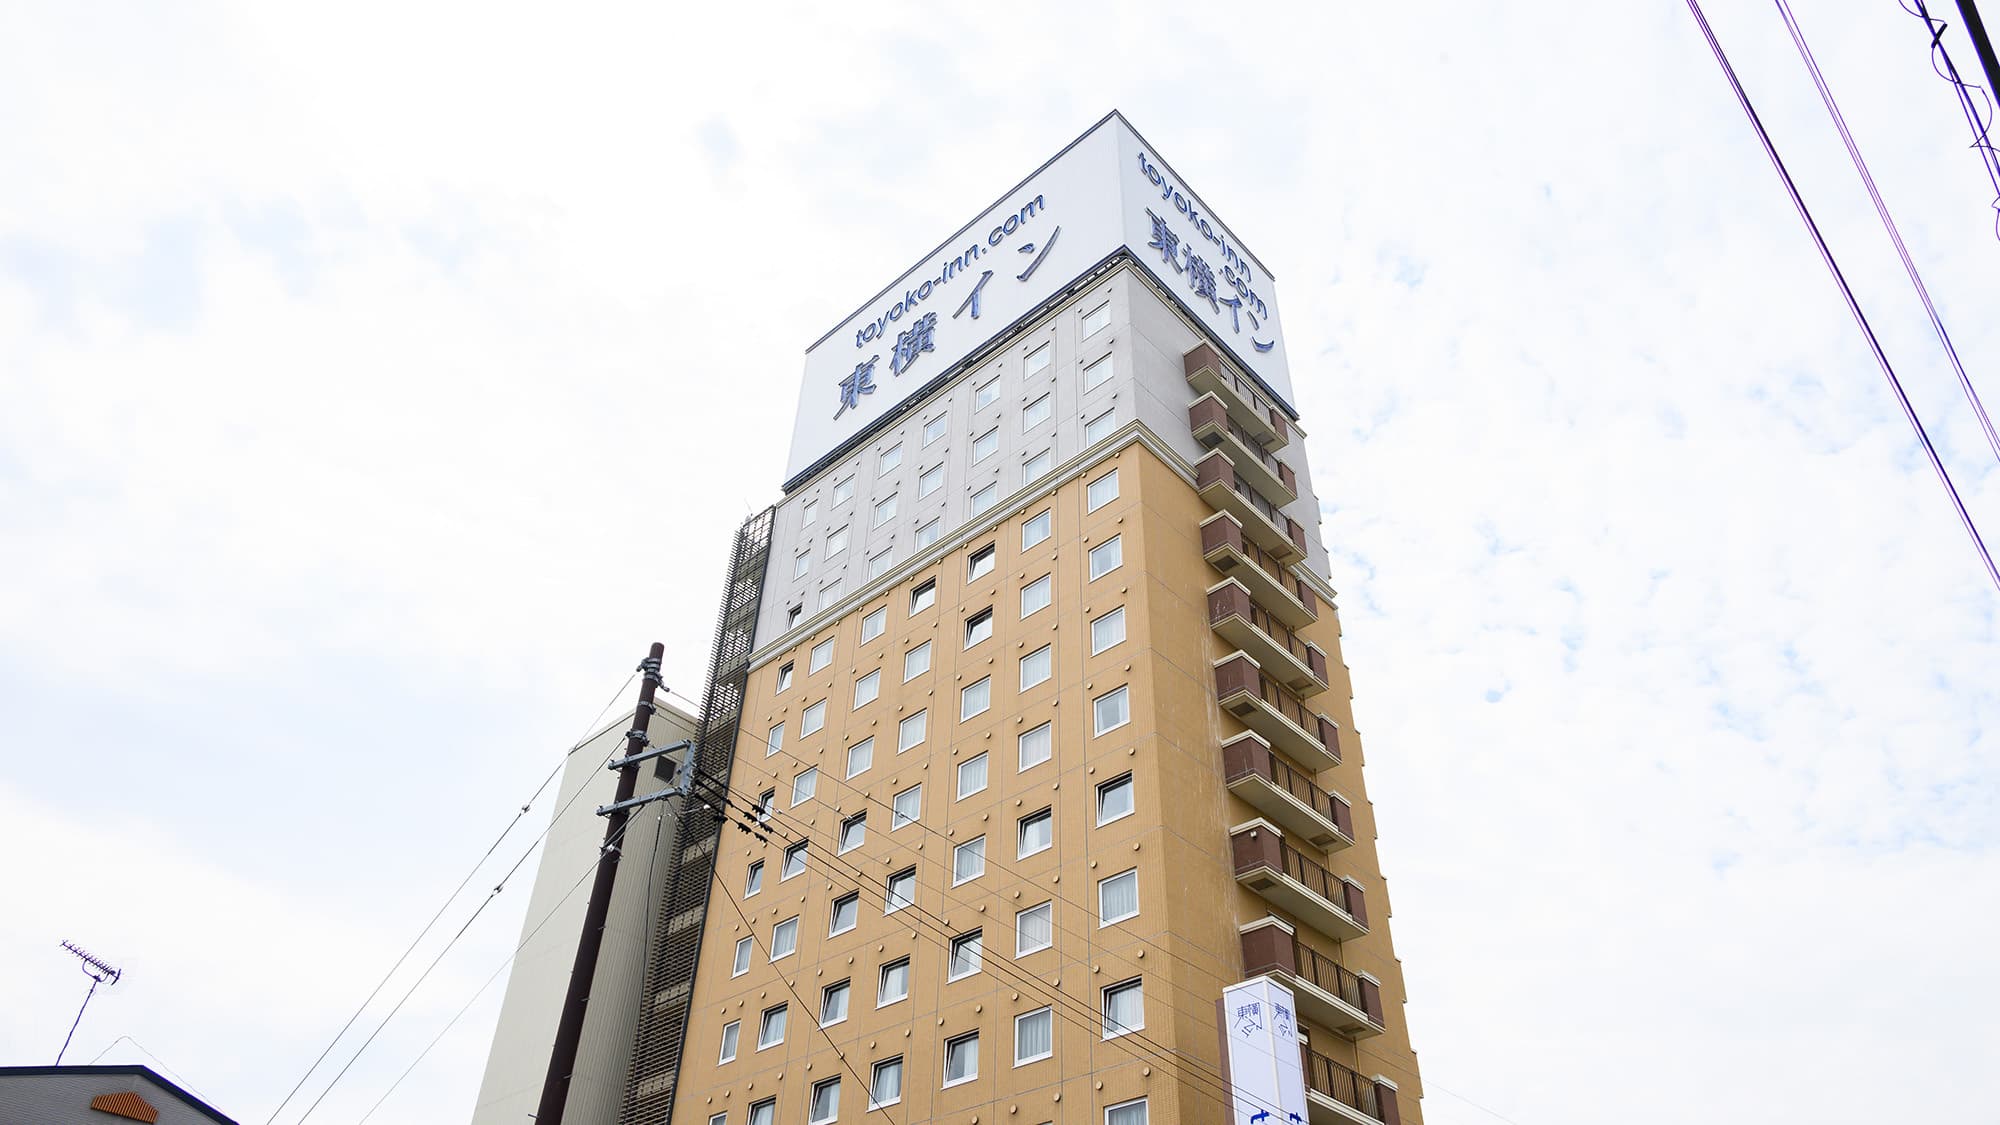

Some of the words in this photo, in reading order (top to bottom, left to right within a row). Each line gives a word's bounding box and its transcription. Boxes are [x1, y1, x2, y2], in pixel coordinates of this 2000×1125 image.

[855, 193, 1046, 348] toyoko-inn.com
[1137, 151, 1252, 283] toyoko-inn
[1145, 206, 1275, 353] 東横イン
[833, 225, 1061, 421] 東横イン
[1218, 265, 1268, 321] .com
